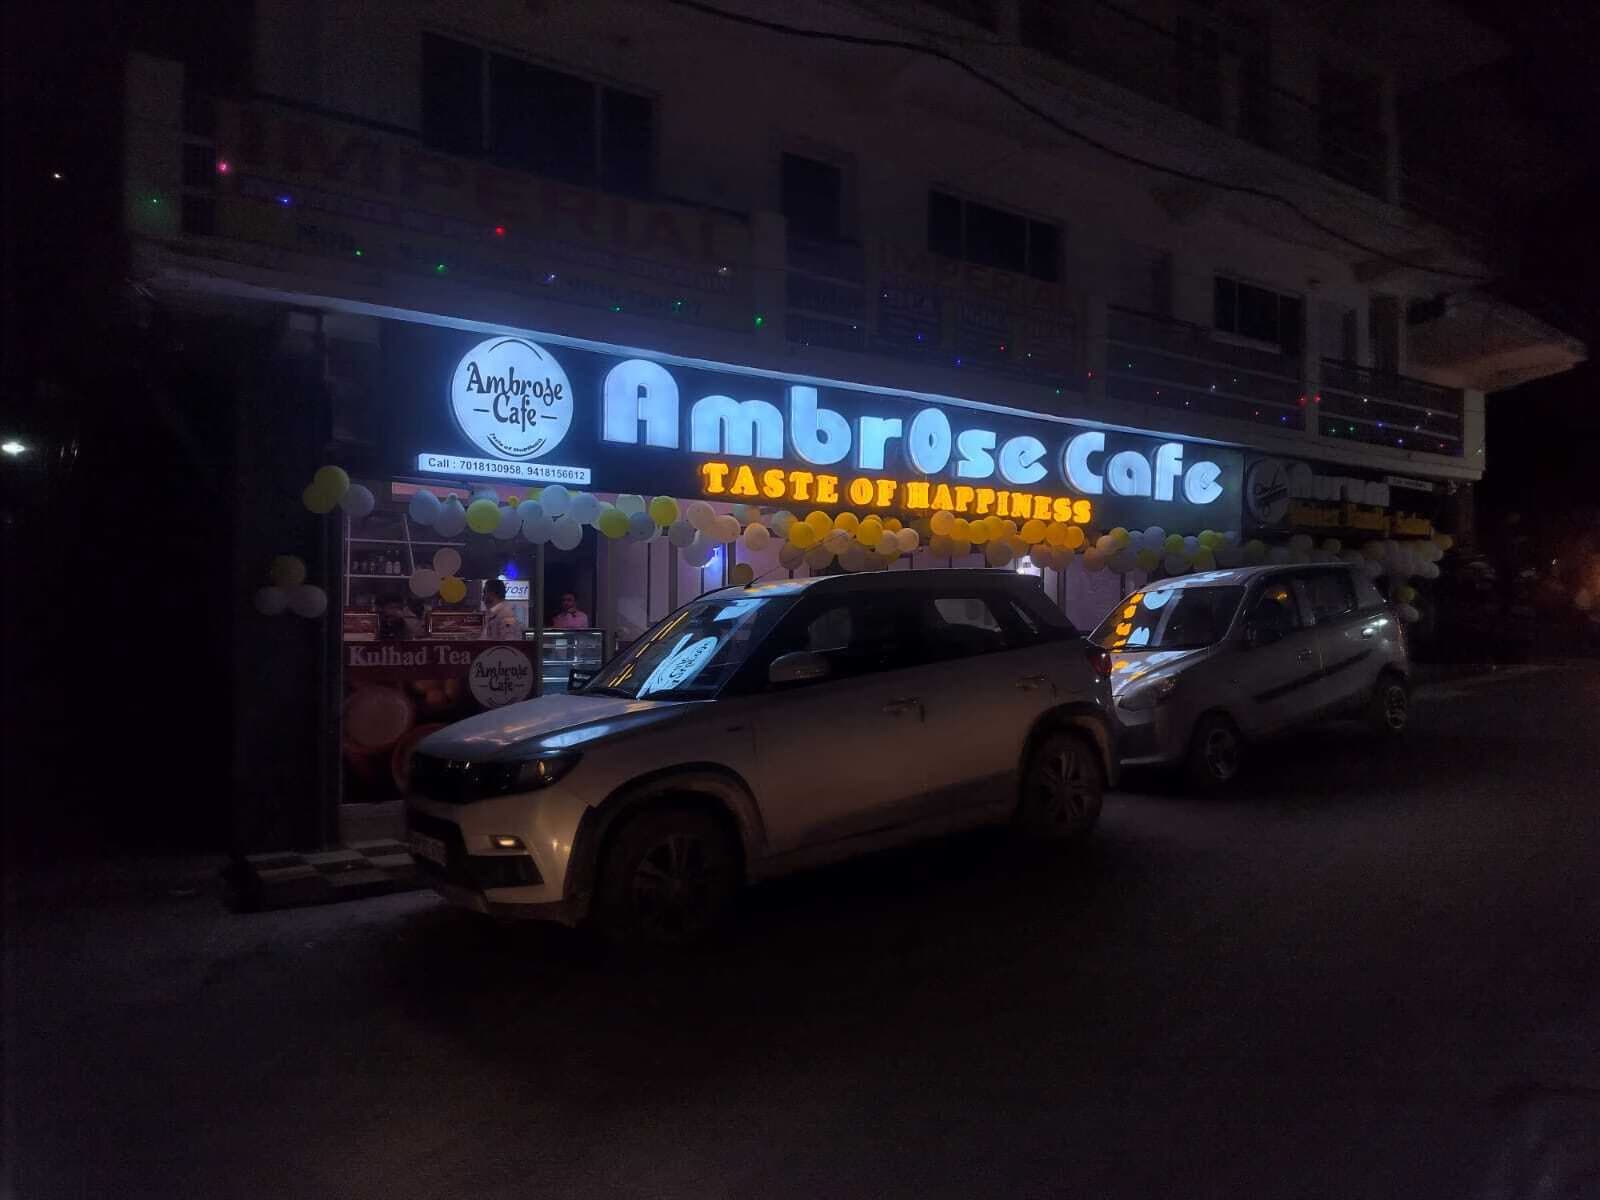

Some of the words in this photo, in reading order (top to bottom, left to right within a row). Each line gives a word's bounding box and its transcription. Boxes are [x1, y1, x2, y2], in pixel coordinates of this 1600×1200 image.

[466, 361, 563, 406] Ambrose
[493, 393, 537, 432] Cafe
[428, 457, 450, 469] Call
[1061, 431, 1224, 505] Cafe
[702, 462, 839, 504] TASTE
[850, 477, 898, 508] OF
[906, 480, 1092, 525] HAPPINESS
[348, 645, 428, 667] Kulhad
[433, 644, 472, 665] Tea
